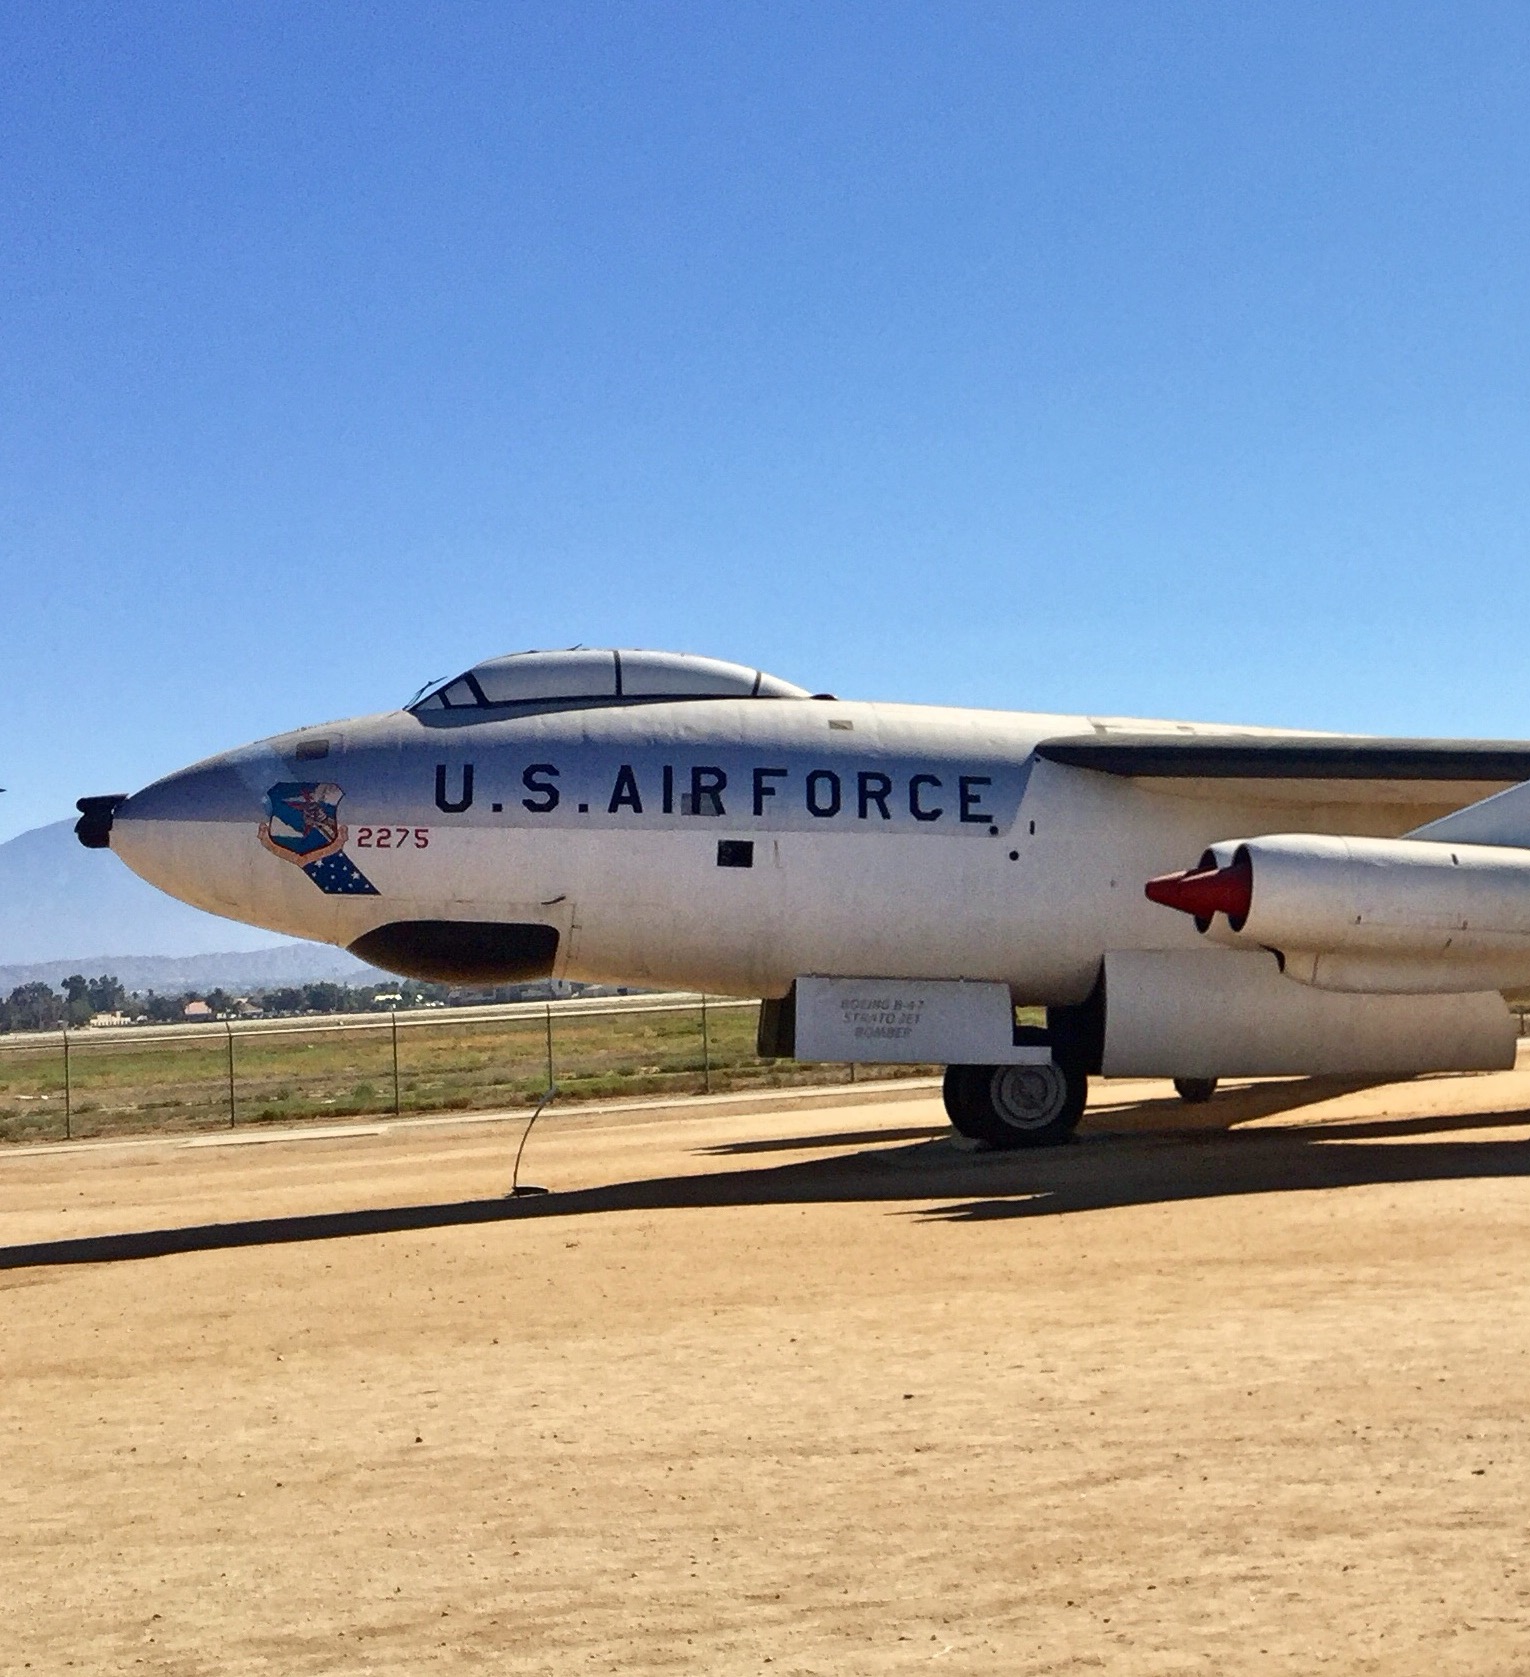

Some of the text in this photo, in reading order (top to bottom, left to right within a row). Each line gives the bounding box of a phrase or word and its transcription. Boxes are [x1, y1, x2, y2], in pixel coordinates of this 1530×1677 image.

[607, 764, 727, 816] AIR
[752, 768, 993, 823] FORCE
[357, 827, 429, 849] 2275
